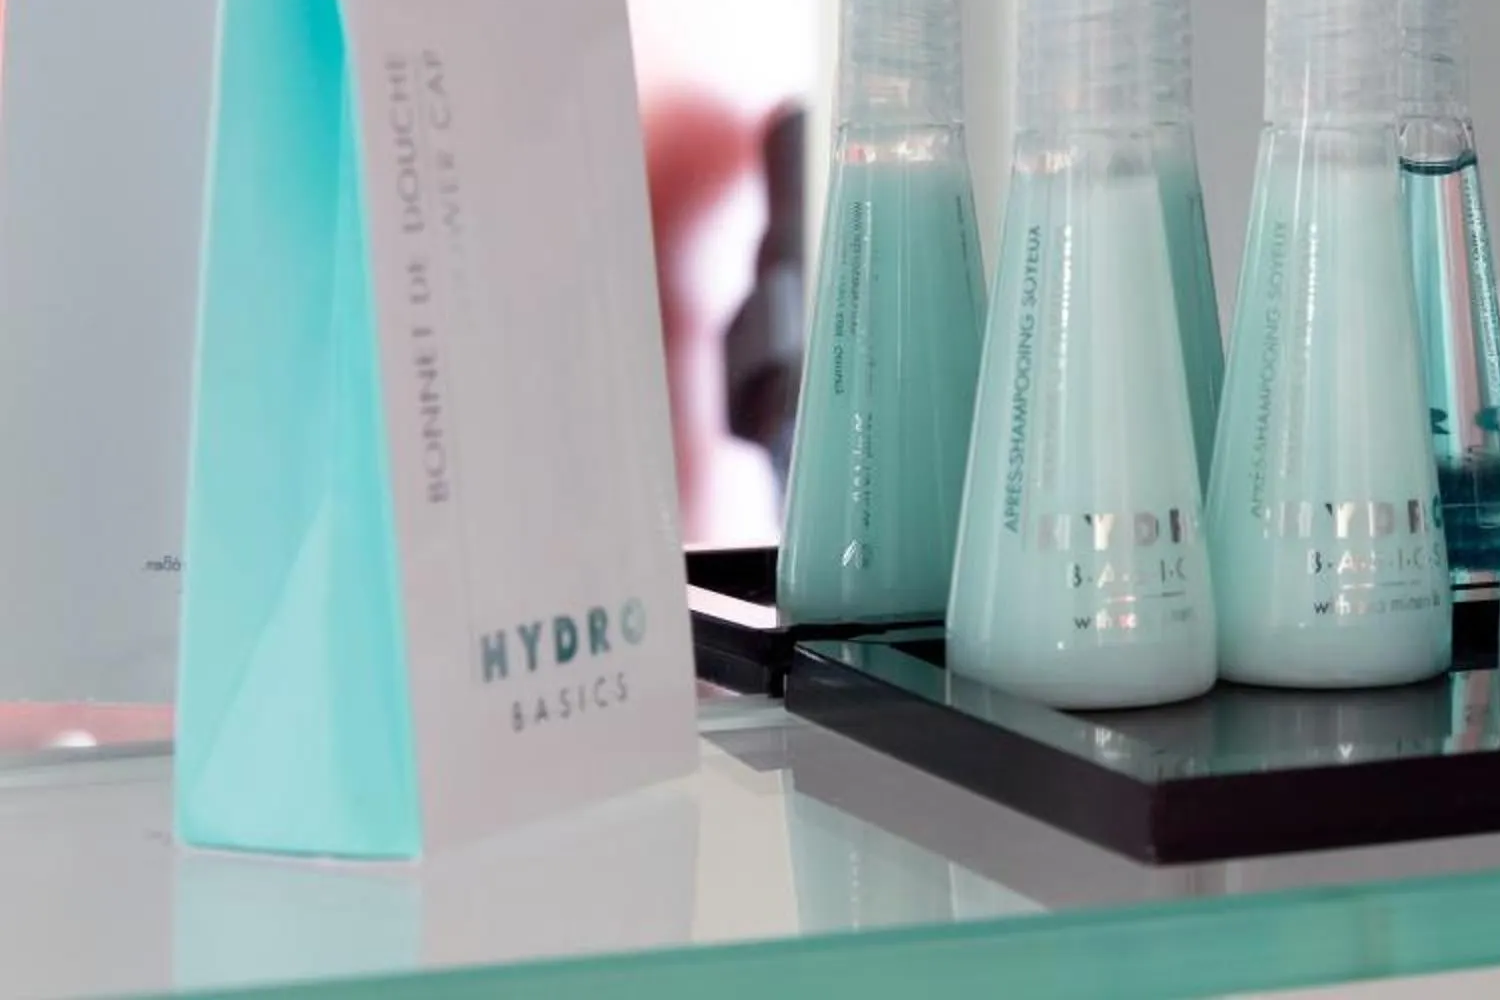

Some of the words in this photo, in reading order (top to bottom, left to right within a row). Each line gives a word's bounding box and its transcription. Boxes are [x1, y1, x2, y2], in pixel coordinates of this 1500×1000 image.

[384, 51, 425, 235] DOUCHE
[404, 256, 432, 307] DE
[479, 596, 648, 684] HYDRO
[510, 670, 629, 735] BASICS
